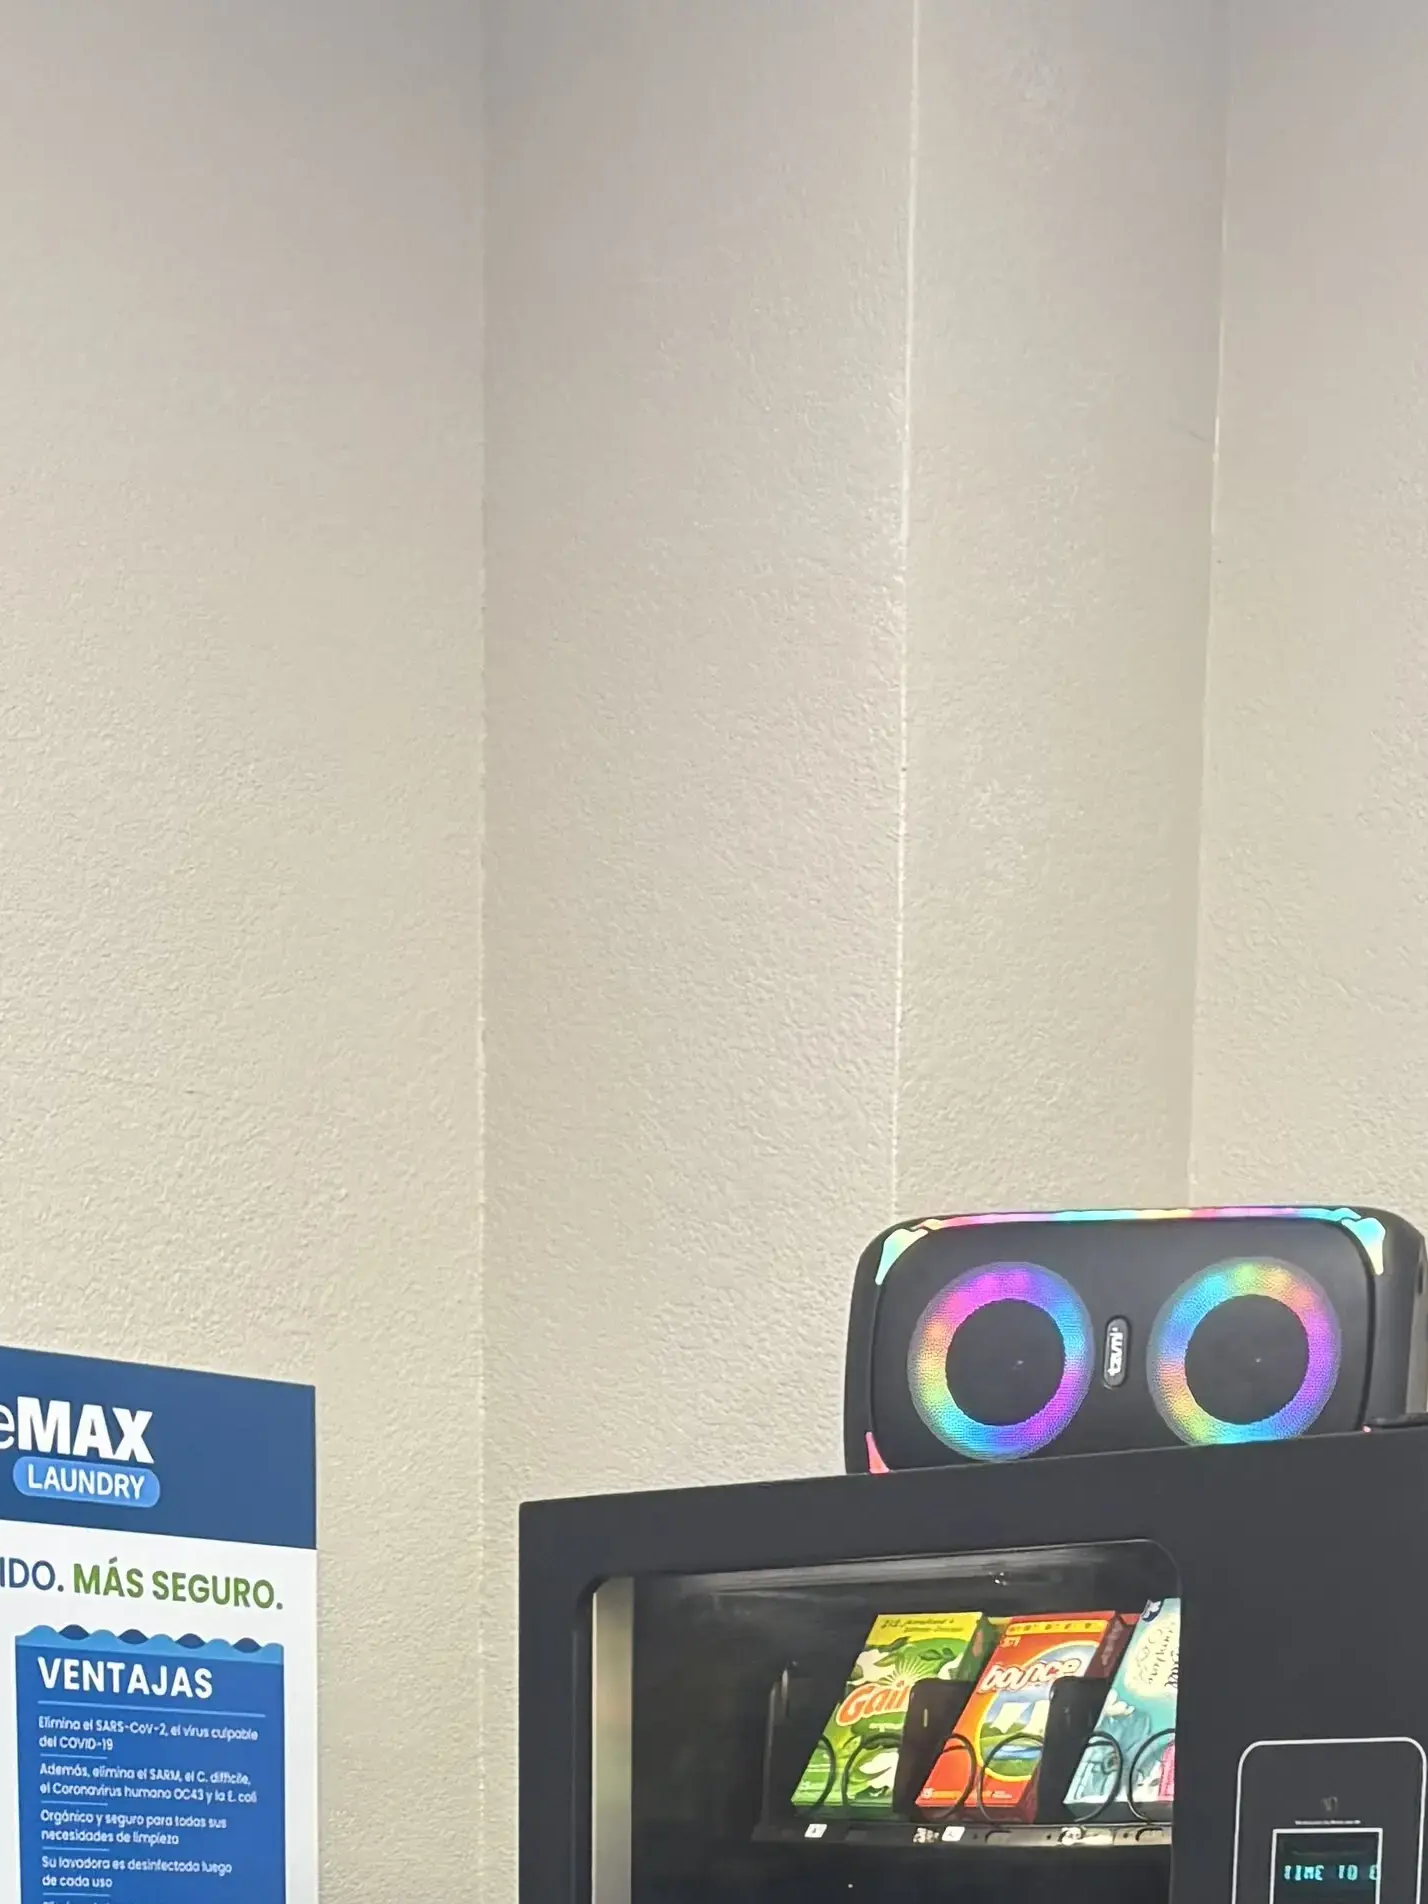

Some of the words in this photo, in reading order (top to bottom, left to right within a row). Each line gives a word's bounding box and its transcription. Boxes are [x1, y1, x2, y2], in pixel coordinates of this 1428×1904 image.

[27, 1463, 144, 1499] LAUNDRY
[73, 1556, 144, 1598] MÁS
[151, 1570, 283, 1610] SEGURO.
[37, 1656, 212, 1699] VENTAJAS
[836, 1681, 912, 1727] Gai
